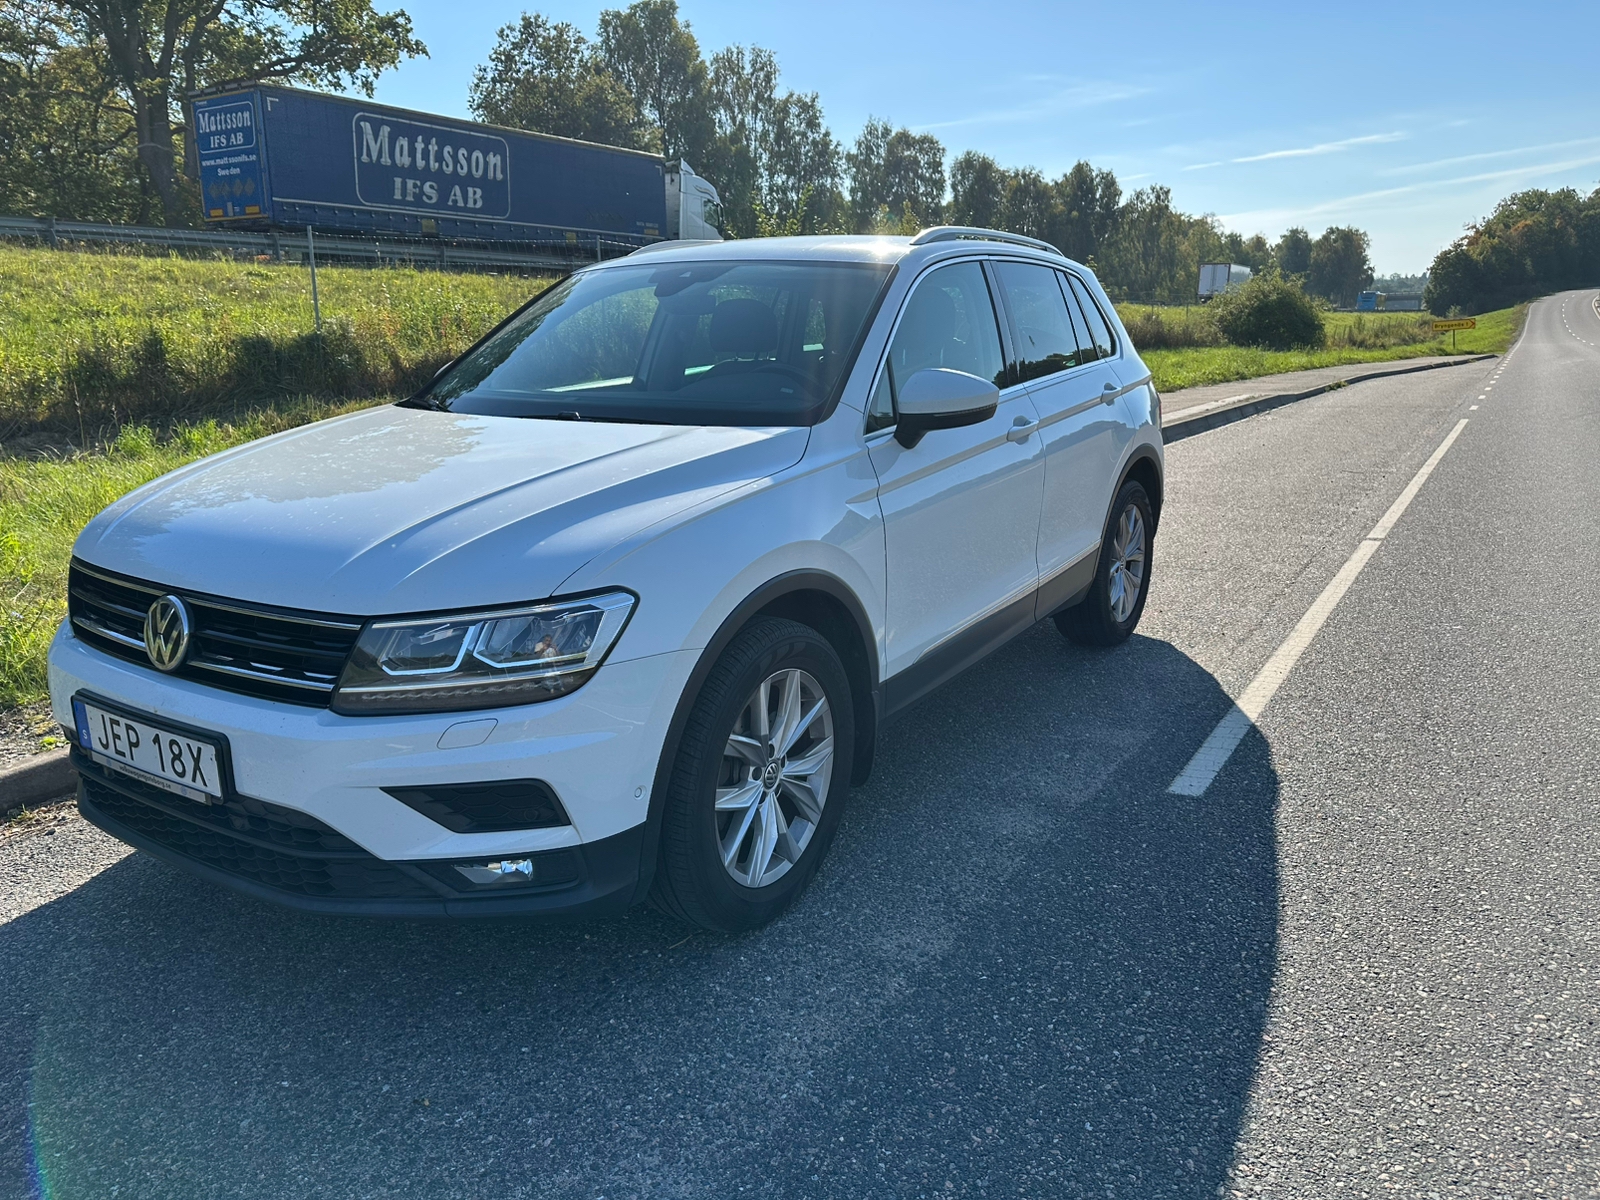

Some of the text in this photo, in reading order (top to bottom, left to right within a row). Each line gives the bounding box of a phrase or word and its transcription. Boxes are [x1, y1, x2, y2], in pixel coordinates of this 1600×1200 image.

[198, 110, 251, 133] Mattsson
[210, 132, 244, 148] IFS AB
[360, 121, 503, 181] Mattsson
[393, 177, 483, 209] IFS AB
[82, 729, 88, 740] S
[98, 714, 208, 788] JEP 18X
